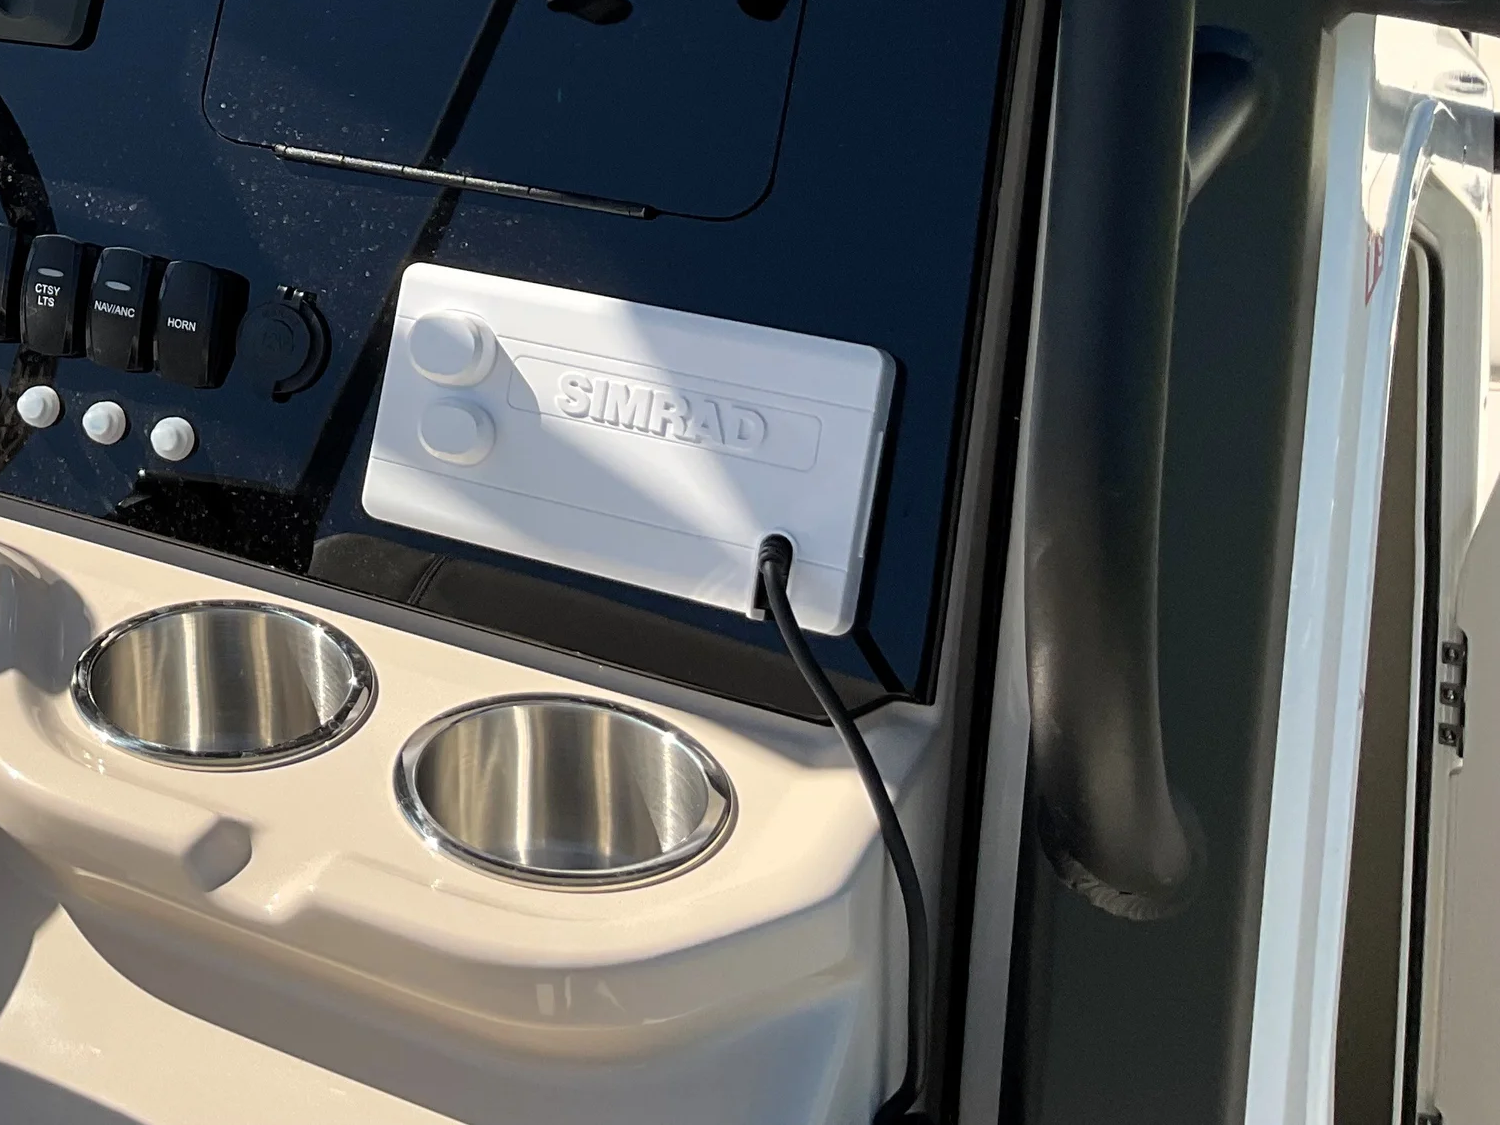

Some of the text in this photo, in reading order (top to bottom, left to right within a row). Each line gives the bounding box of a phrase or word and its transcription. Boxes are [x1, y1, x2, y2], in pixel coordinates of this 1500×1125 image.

[35, 283, 61, 297] CTSY
[37, 295, 55, 307] LTS
[94, 300, 136, 318] NAV/ANC
[167, 317, 196, 332] HORN
[555, 370, 769, 451] SIMRAD
